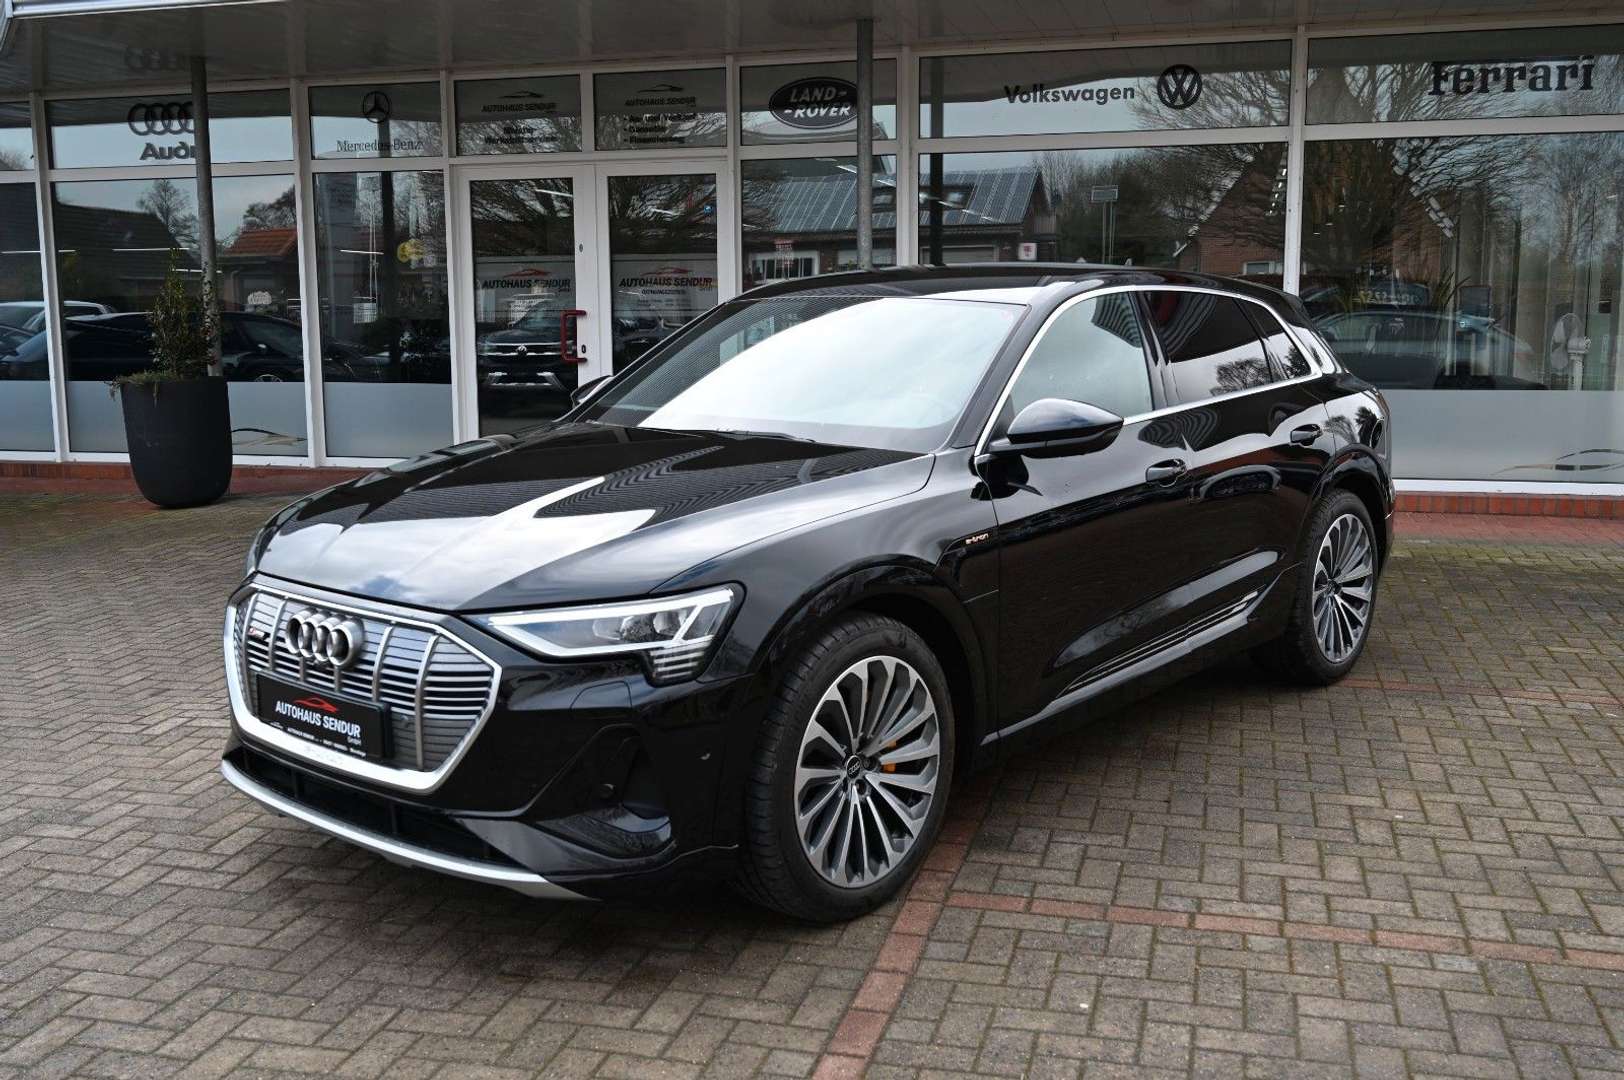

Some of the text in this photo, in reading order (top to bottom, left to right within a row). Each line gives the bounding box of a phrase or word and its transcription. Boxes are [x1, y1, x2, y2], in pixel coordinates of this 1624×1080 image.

[1428, 54, 1595, 96] Ferrari
[1004, 83, 1135, 105] Volkswagen
[482, 279, 532, 289] AUTOHAUS
[618, 277, 713, 288] AUTOHAUS SENDUR
[275, 700, 322, 727] AUTOHAUS
[322, 715, 361, 738] SENDUR
